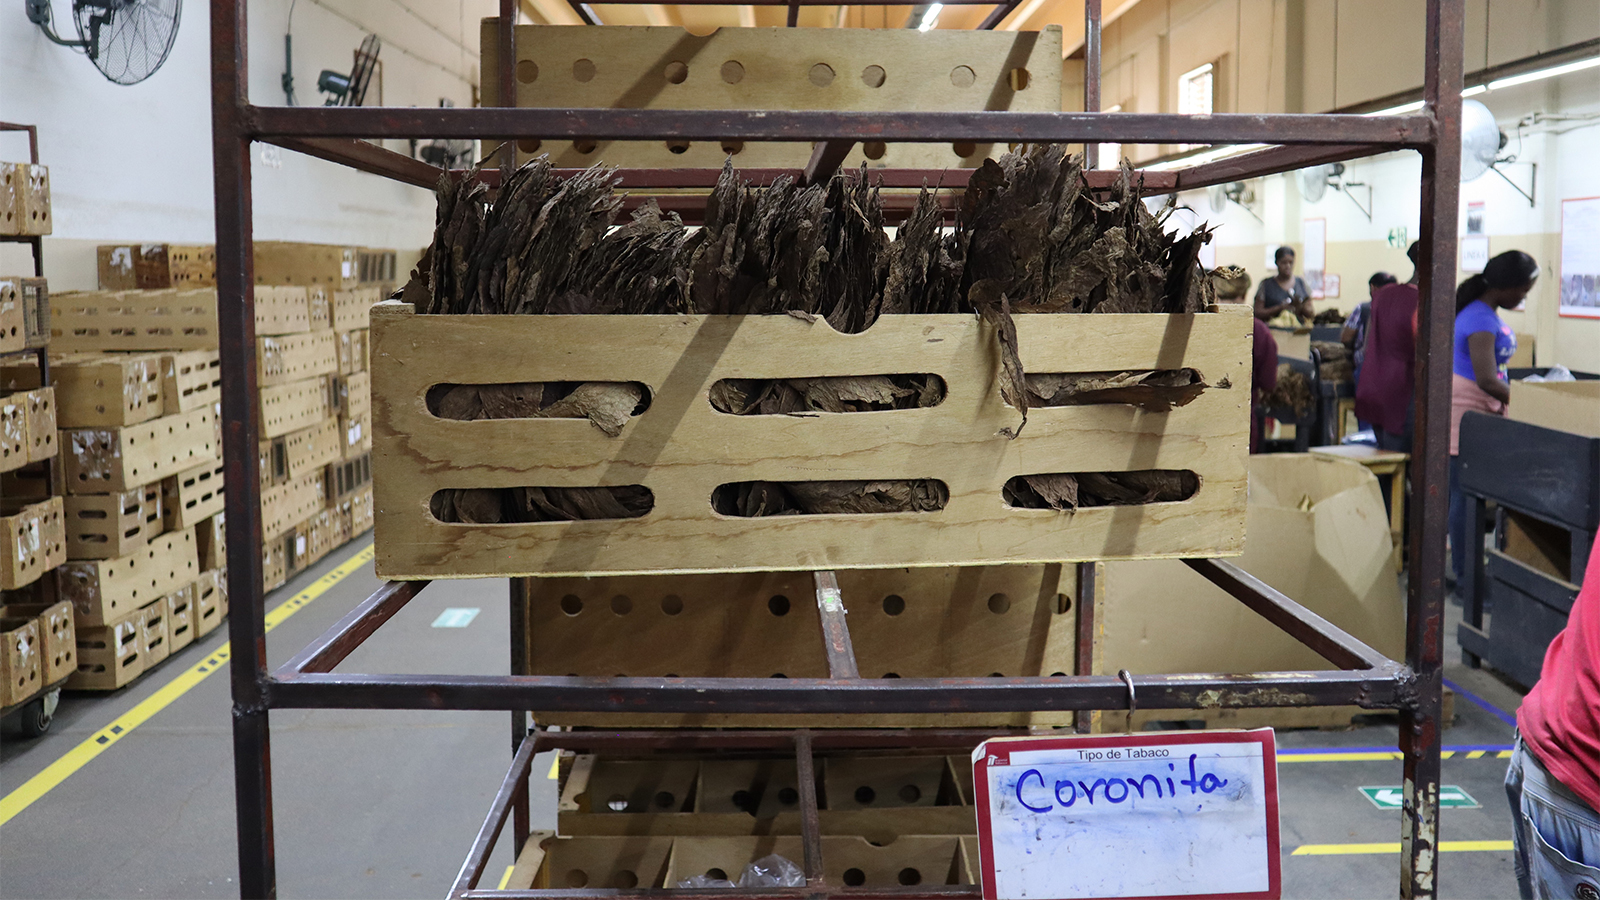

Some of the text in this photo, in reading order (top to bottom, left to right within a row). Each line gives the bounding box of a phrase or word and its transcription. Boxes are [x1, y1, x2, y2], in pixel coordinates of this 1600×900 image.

[1077, 748, 1169, 762] Tipo de Tabaco
[1015, 753, 1228, 813] Coronita
